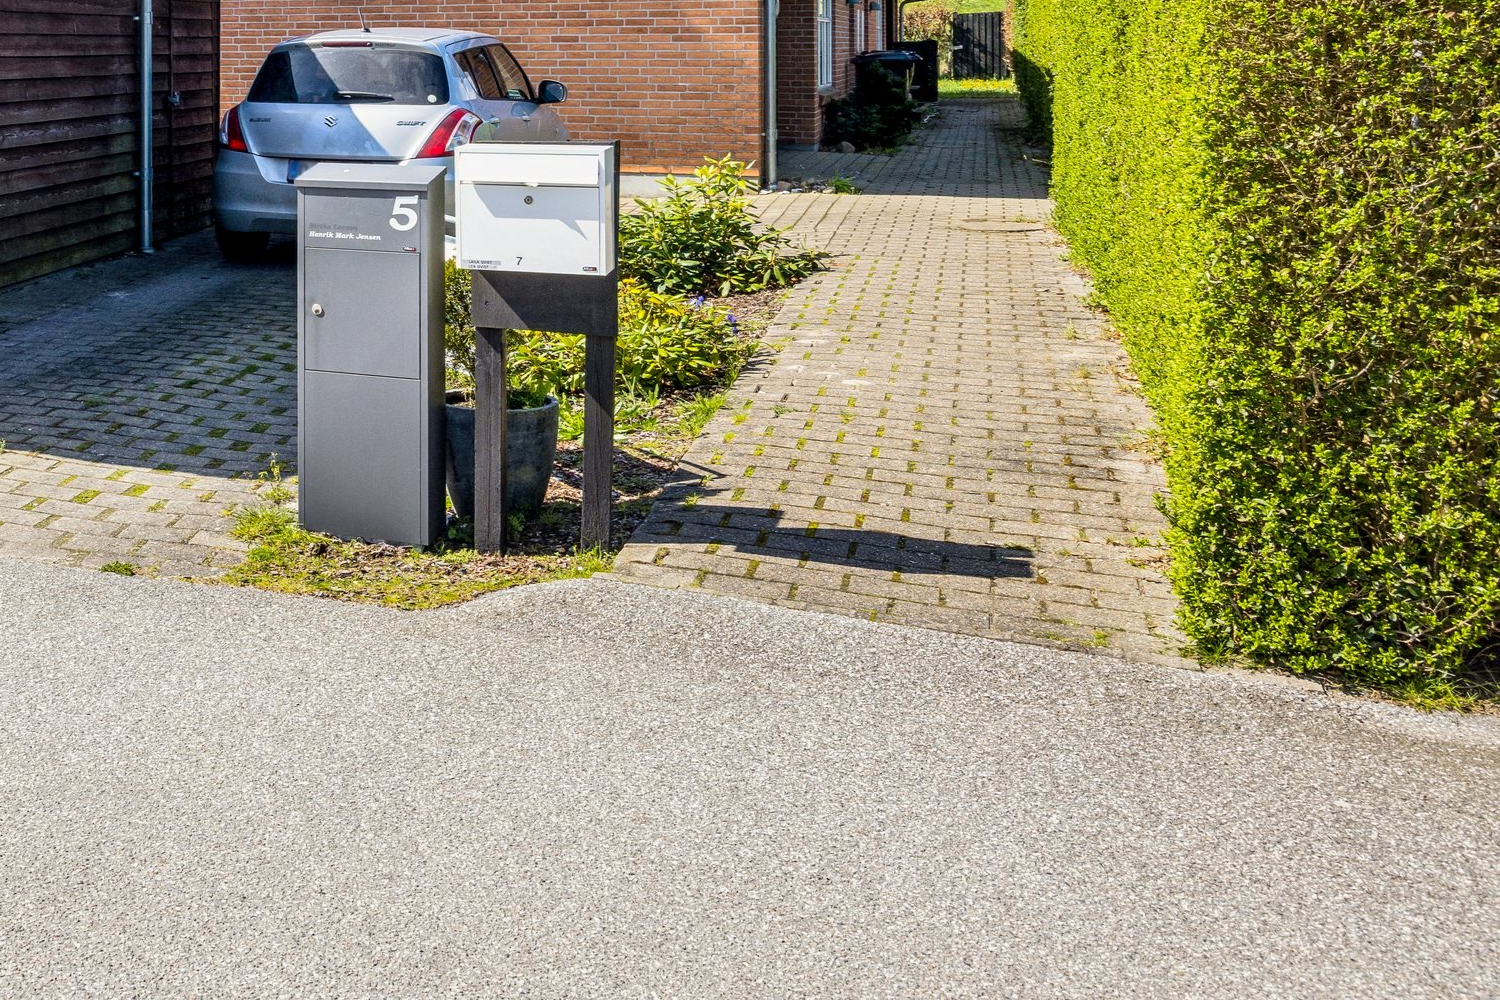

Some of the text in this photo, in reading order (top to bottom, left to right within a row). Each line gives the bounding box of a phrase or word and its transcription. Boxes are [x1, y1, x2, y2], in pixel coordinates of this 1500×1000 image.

[389, 195, 419, 231] 5
[356, 233, 381, 241] Jensen
[516, 256, 523, 266] 7
